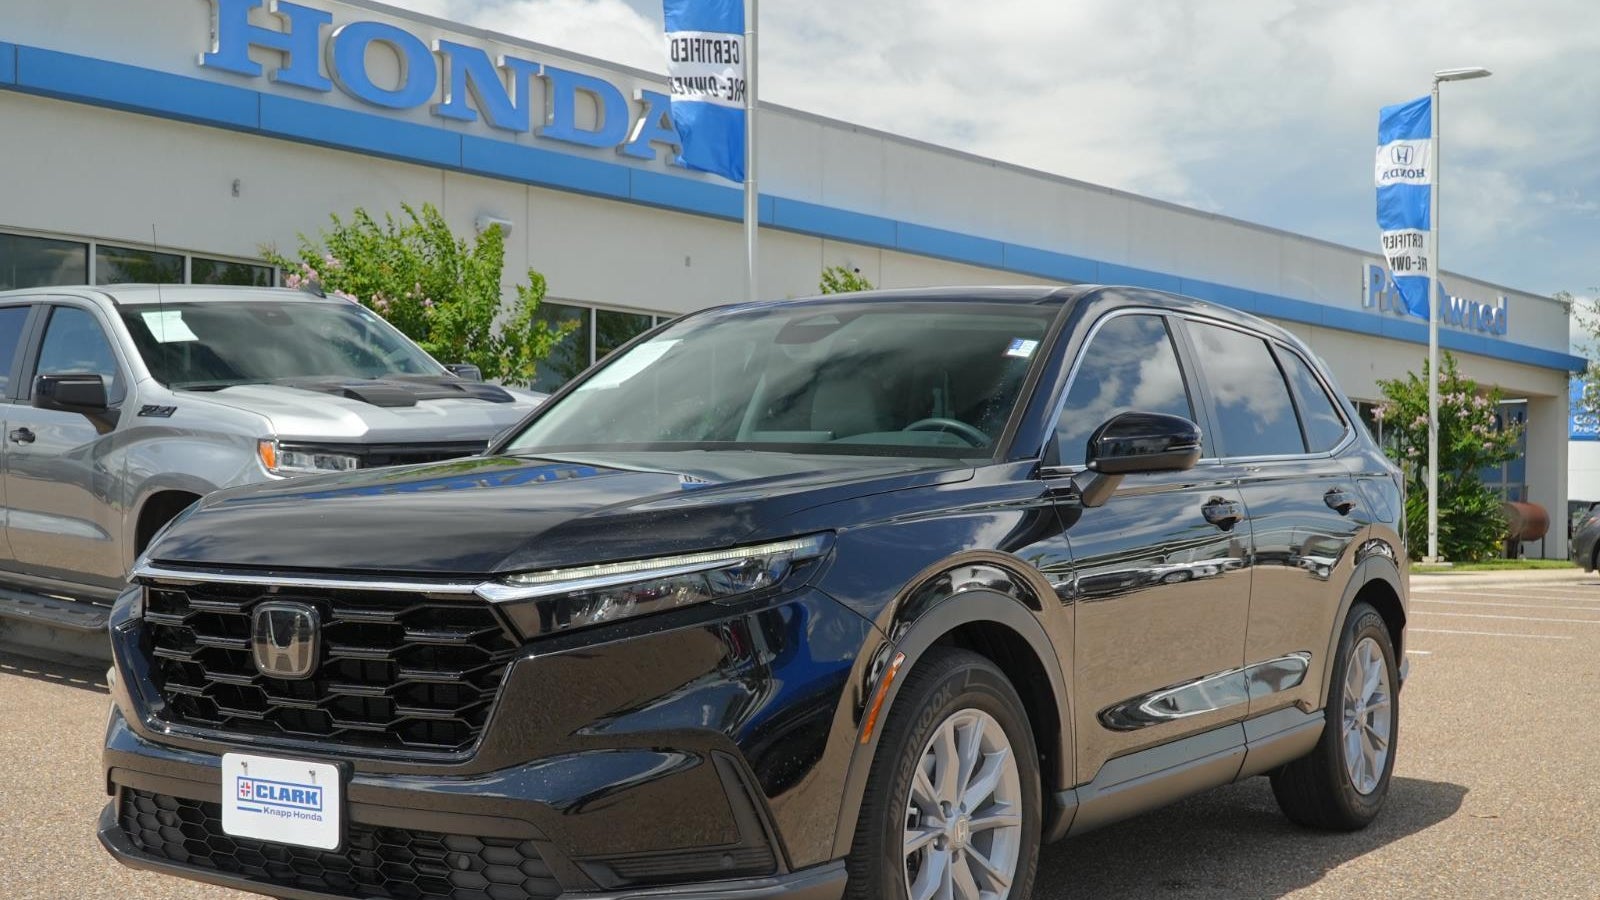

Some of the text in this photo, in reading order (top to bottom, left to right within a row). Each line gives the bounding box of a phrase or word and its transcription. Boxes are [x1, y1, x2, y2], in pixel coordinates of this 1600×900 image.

[199, 0, 685, 168] HONDA
[255, 784, 319, 806] CLARK
[263, 806, 323, 822] Knapp Honda
